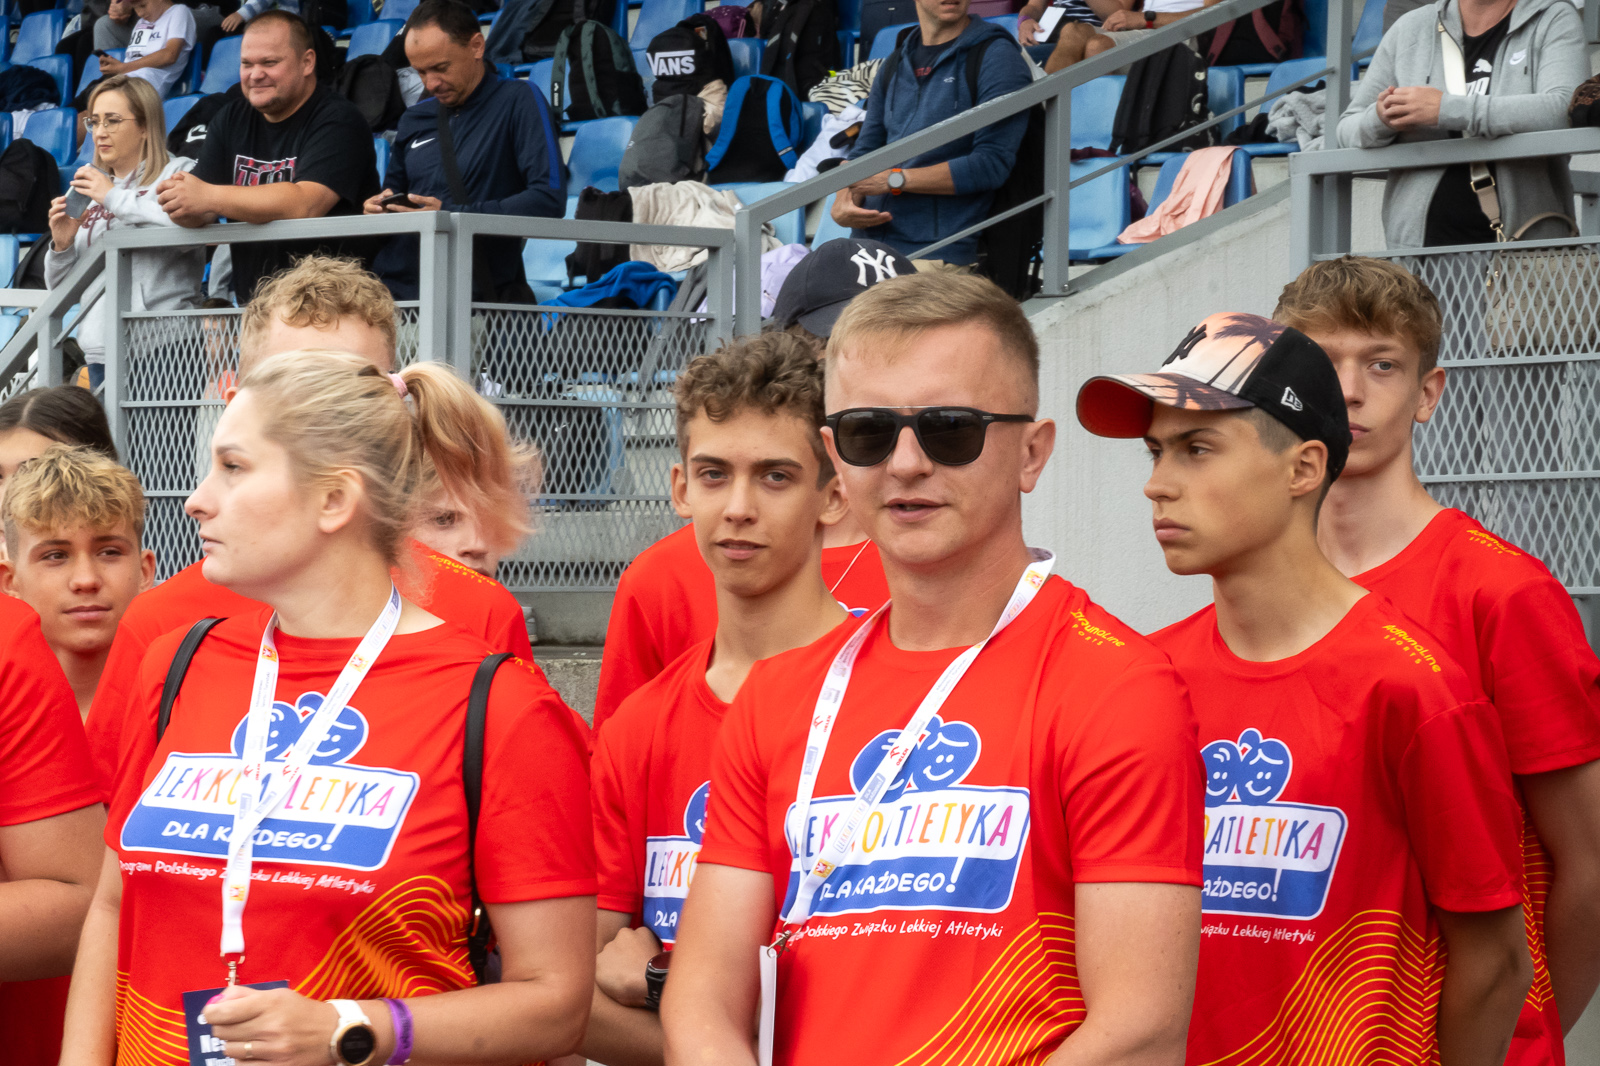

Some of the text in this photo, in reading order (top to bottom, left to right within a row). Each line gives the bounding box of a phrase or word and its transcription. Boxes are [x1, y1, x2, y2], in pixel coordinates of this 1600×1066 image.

[646, 49, 696, 76] VANS
[154, 766, 395, 817] LEKKLETYKA
[161, 821, 344, 852] DLA KDEGO!
[1204, 814, 1325, 860] ATLETYKA
[155, 860, 217, 881] Polskiego
[1202, 868, 1283, 902] AŻDEGO!
[654, 910, 678, 928] DLA
[851, 919, 896, 937] Związku
[899, 918, 943, 939] Lekkiej
[945, 920, 1003, 940] Atletyki
[1232, 924, 1272, 943] Lekkiej
